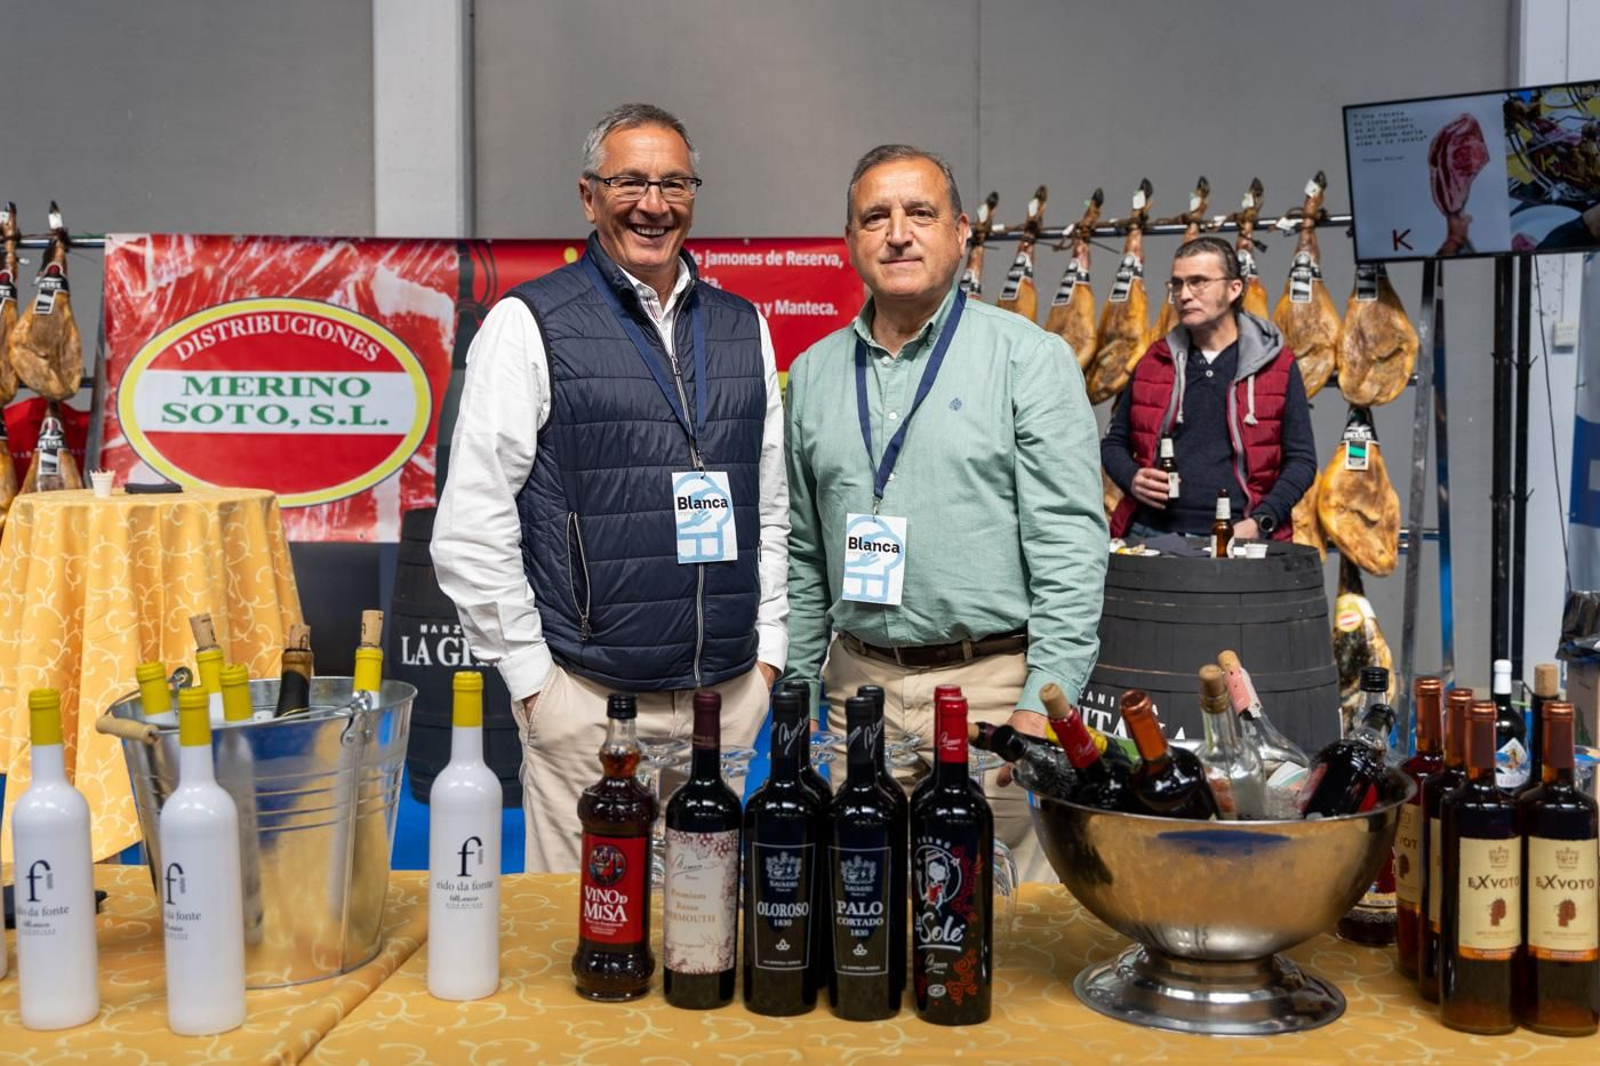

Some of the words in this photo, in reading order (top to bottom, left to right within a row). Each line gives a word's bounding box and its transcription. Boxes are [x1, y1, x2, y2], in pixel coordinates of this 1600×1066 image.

[1392, 228, 1414, 251] K
[704, 250, 763, 268] jamones
[766, 250, 782, 266] de
[786, 250, 844, 269] Reserva,
[764, 302, 774, 318] y
[775, 299, 839, 316] Manteca.
[174, 314, 381, 362] DISTRIBUCIONES
[182, 376, 371, 398] MERINO
[162, 403, 300, 428] SOTO,
[309, 404, 390, 427] S.L.
[676, 495, 729, 511] Blanca
[848, 536, 901, 554] Blanca
[401, 635, 433, 666] LA
[456, 835, 483, 877] f
[26, 859, 51, 902] f
[165, 862, 184, 905] f
[585, 885, 620, 905] VINO
[41, 905, 70, 917] fonte
[176, 911, 202, 921] fonte
[584, 900, 629, 922] MISA
[757, 901, 809, 917] OLOROSO
[836, 900, 884, 916] PALO
[836, 917, 885, 927] CORTADO
